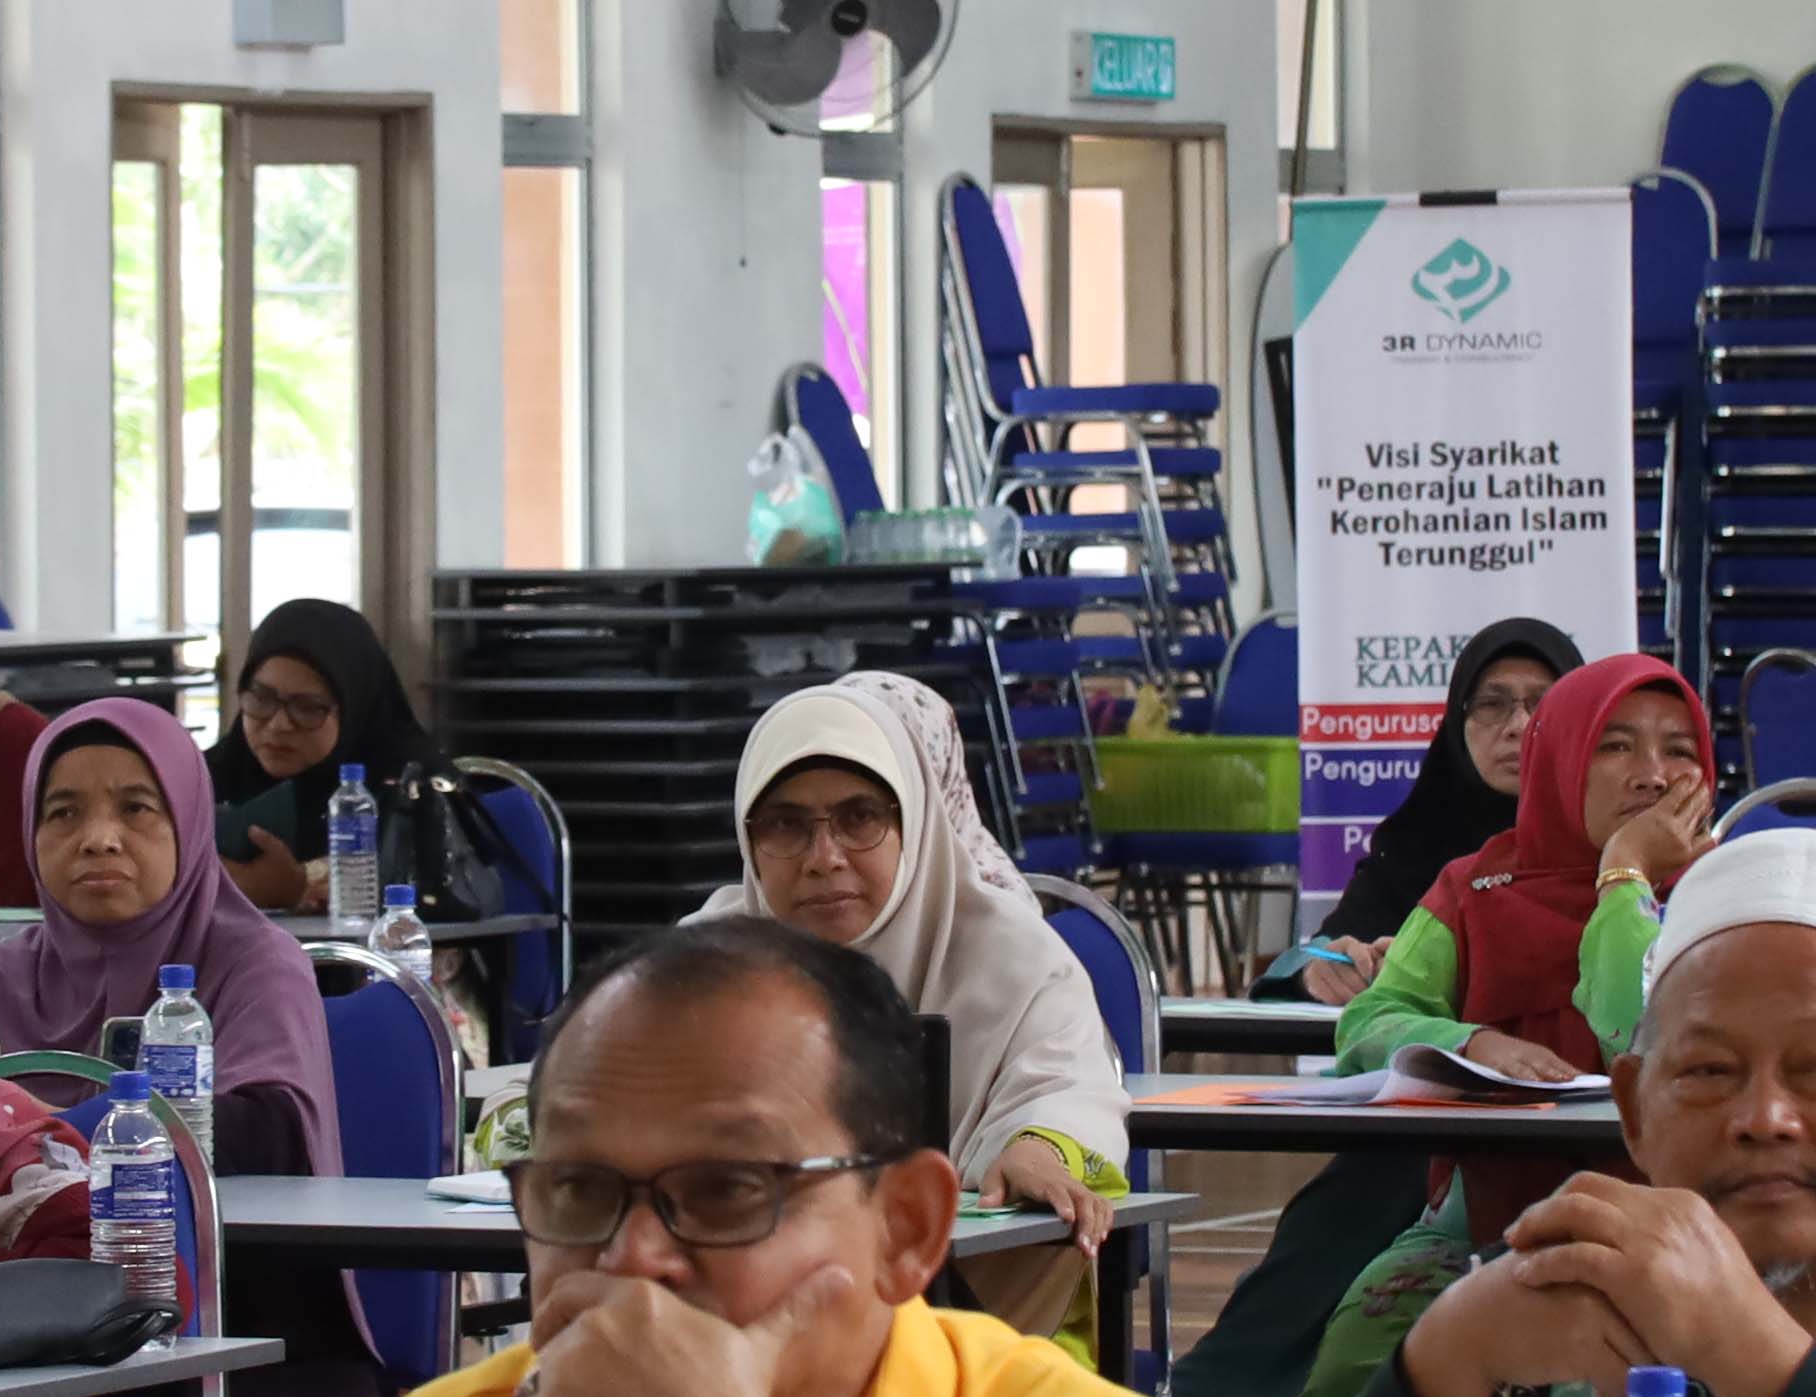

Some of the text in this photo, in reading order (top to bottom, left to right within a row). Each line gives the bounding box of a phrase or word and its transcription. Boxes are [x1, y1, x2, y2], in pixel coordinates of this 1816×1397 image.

[1382, 331, 1543, 352] 3R DYNAMIC
[1365, 441, 1560, 473] Visi Syarikat
[1317, 473, 1606, 506] "Peneraju Latihan
[1330, 506, 1608, 536] Kerohanian Islam
[1379, 539, 1554, 572] Terunggul"
[1357, 662, 1450, 688] KAMI
